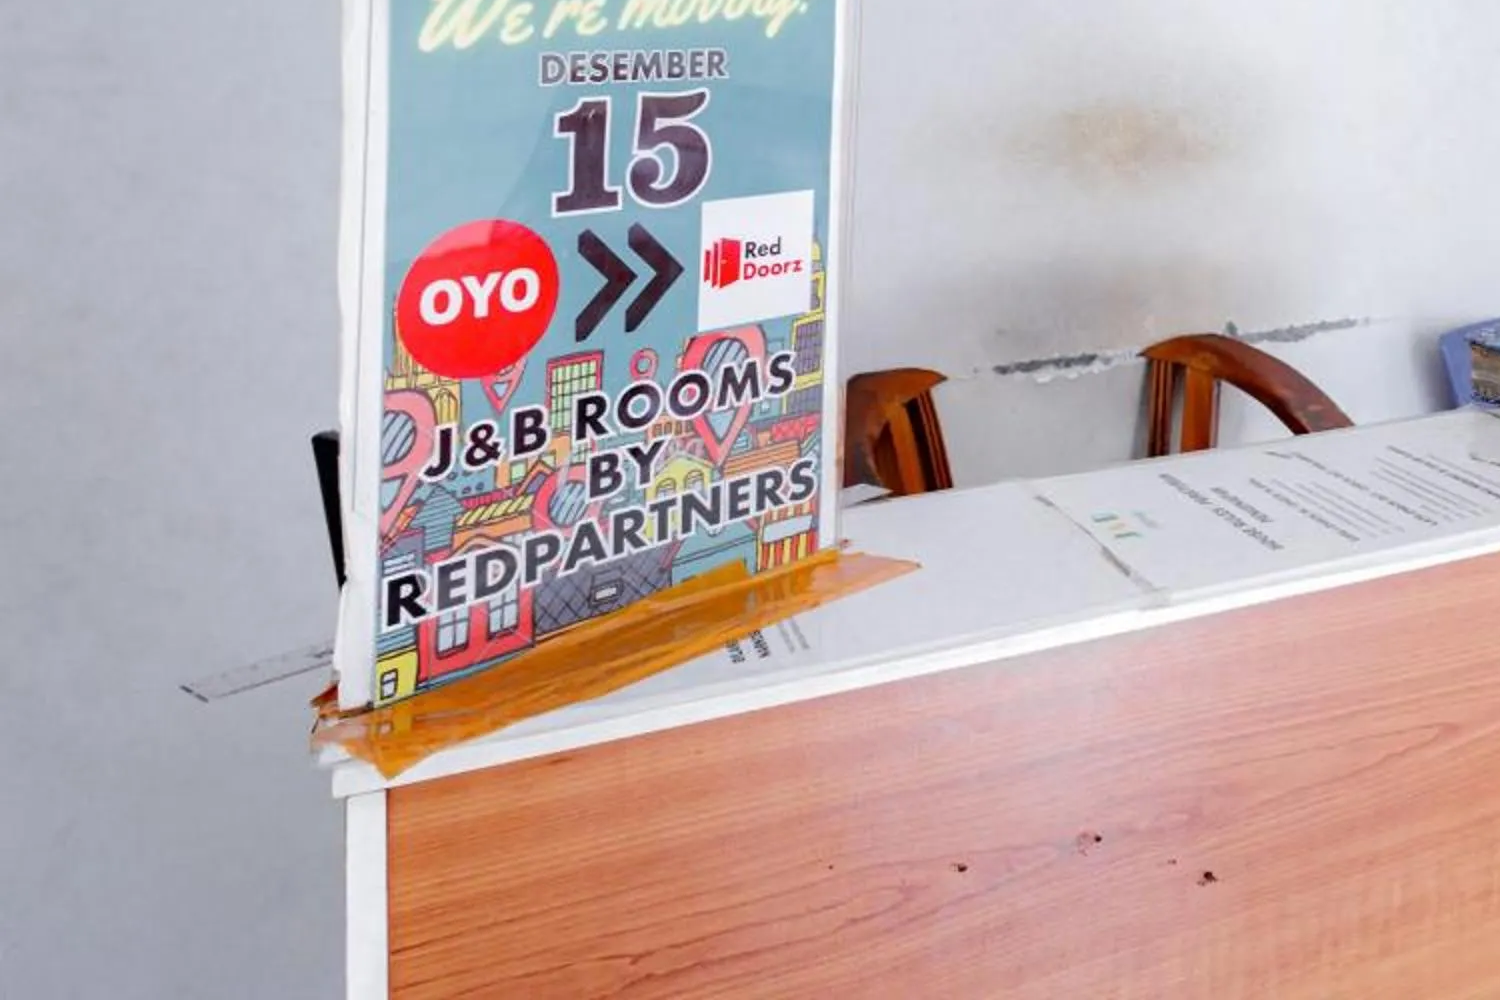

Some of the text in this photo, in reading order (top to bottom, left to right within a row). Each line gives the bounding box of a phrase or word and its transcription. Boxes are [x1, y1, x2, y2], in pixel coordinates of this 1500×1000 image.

[540, 48, 728, 87] DESEMBER
[552, 89, 711, 217] 15
[742, 258, 803, 281] Doorz
[744, 236, 783, 260] Red
[418, 267, 540, 326] OYO
[425, 353, 796, 479] J&B ROOMS
[588, 440, 667, 500] BY
[384, 459, 818, 629] REDPARTNERS
